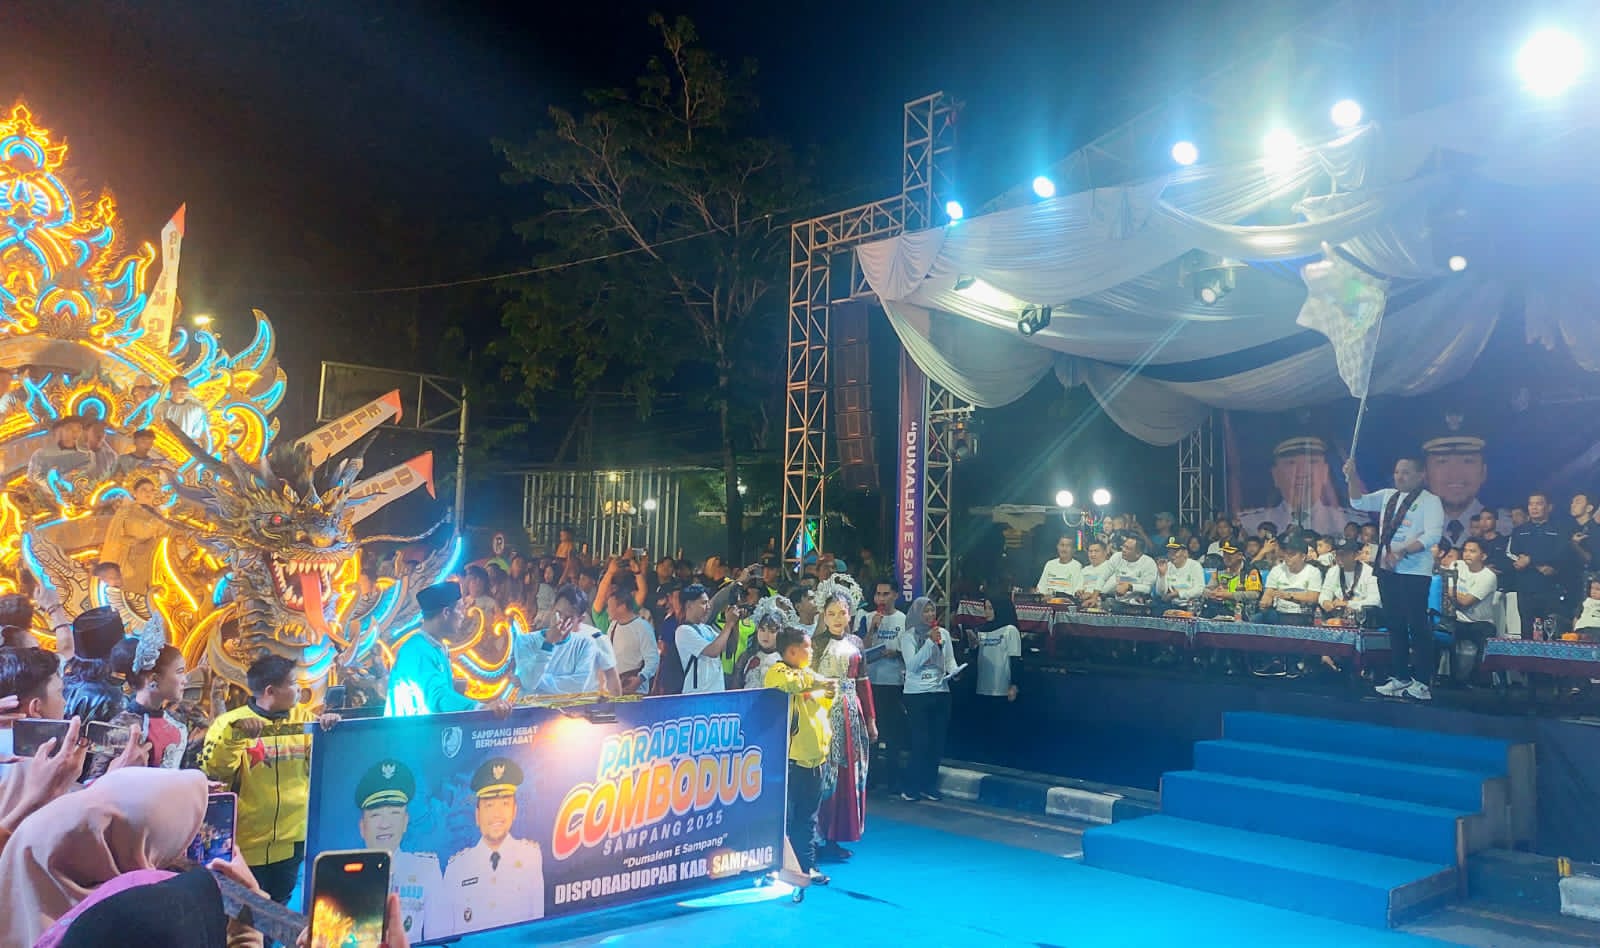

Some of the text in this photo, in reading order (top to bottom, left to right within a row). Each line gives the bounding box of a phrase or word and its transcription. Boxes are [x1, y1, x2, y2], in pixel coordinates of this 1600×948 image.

[472, 725, 538, 740] SAMPANG HEBAT
[475, 734, 533, 749] BERMARTABAT
[600, 714, 743, 778] PARADE DAUL
[552, 746, 763, 860] COMBODUG
[603, 810, 723, 856] SAMPANG 2025
[623, 832, 728, 868] "Dumalem E Sampang"
[555, 846, 773, 905] DISPORABUDPAR KAB. SAMPANG
